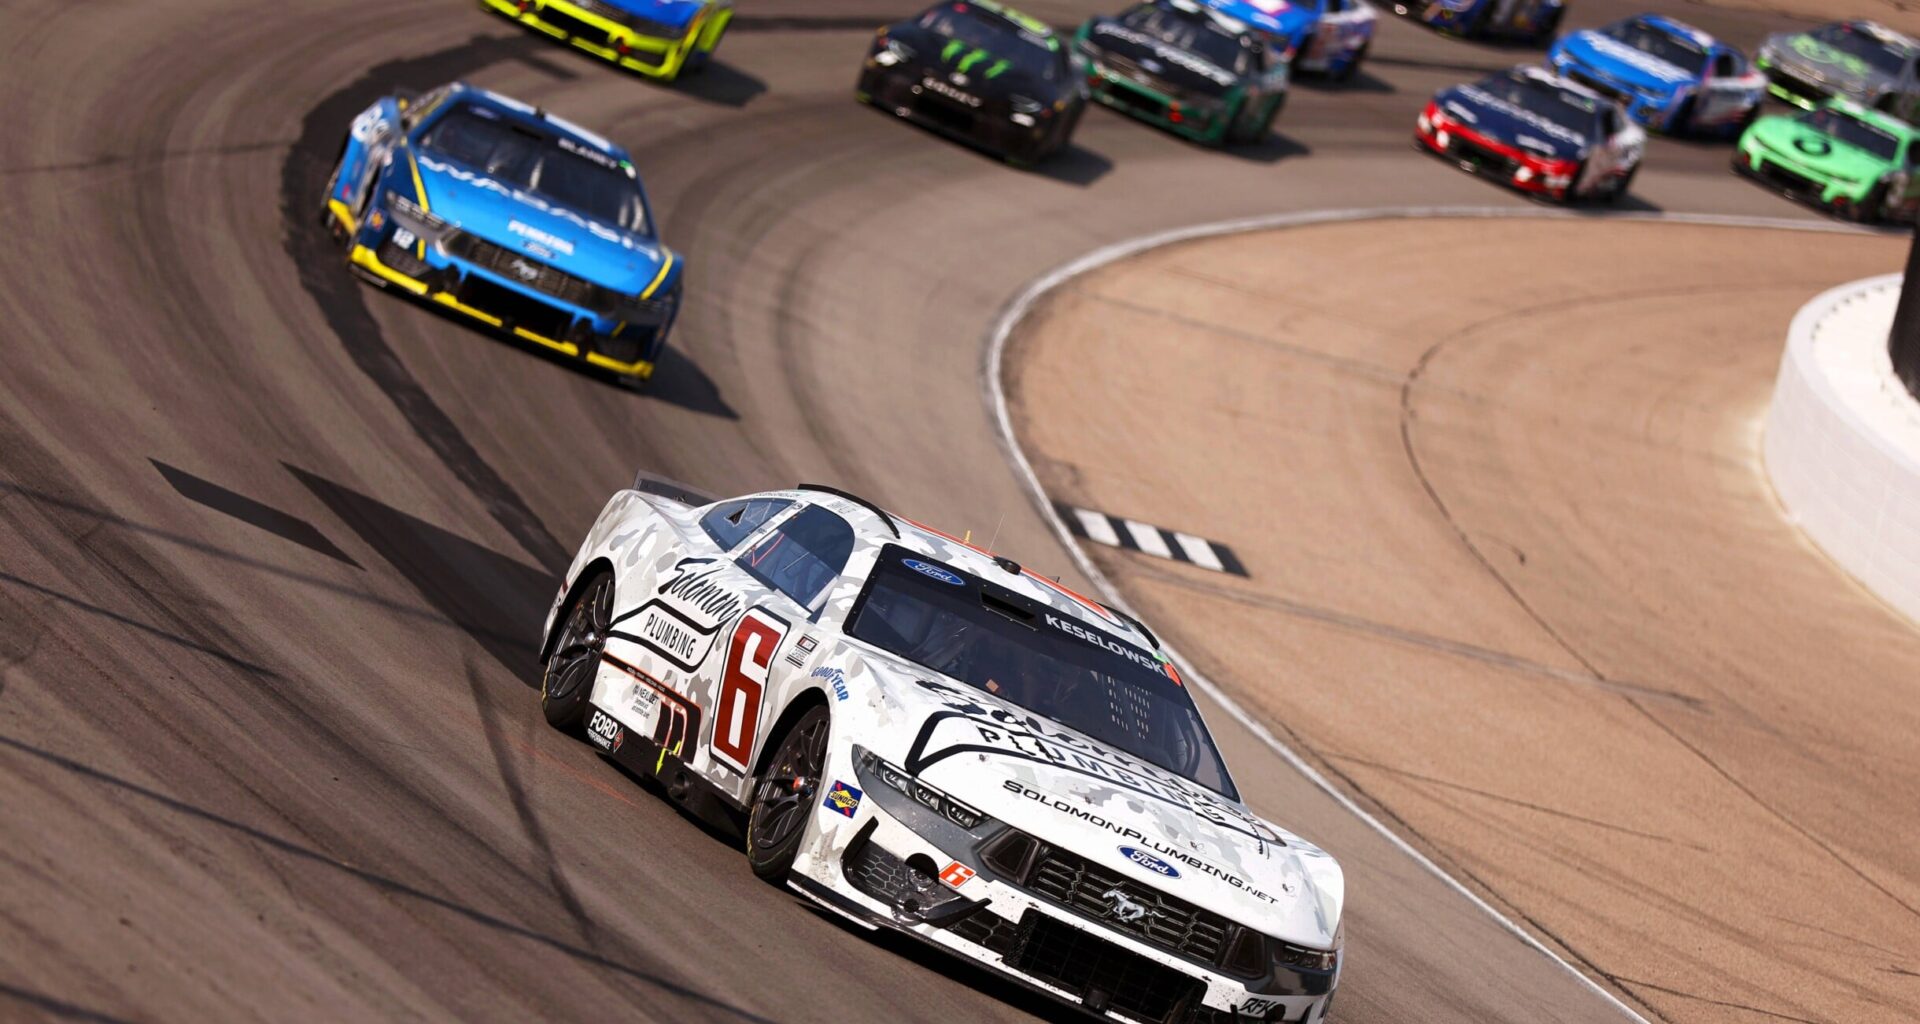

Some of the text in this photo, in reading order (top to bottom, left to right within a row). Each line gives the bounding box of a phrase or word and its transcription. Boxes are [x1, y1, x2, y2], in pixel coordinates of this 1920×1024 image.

[643, 613, 697, 660] PLUMBING
[714, 615, 781, 768] 6
[587, 728, 612, 751] PERFORMANCE
[590, 711, 618, 740] FORD
[830, 791, 858, 807] SUNOCO
[939, 861, 976, 888] 6
